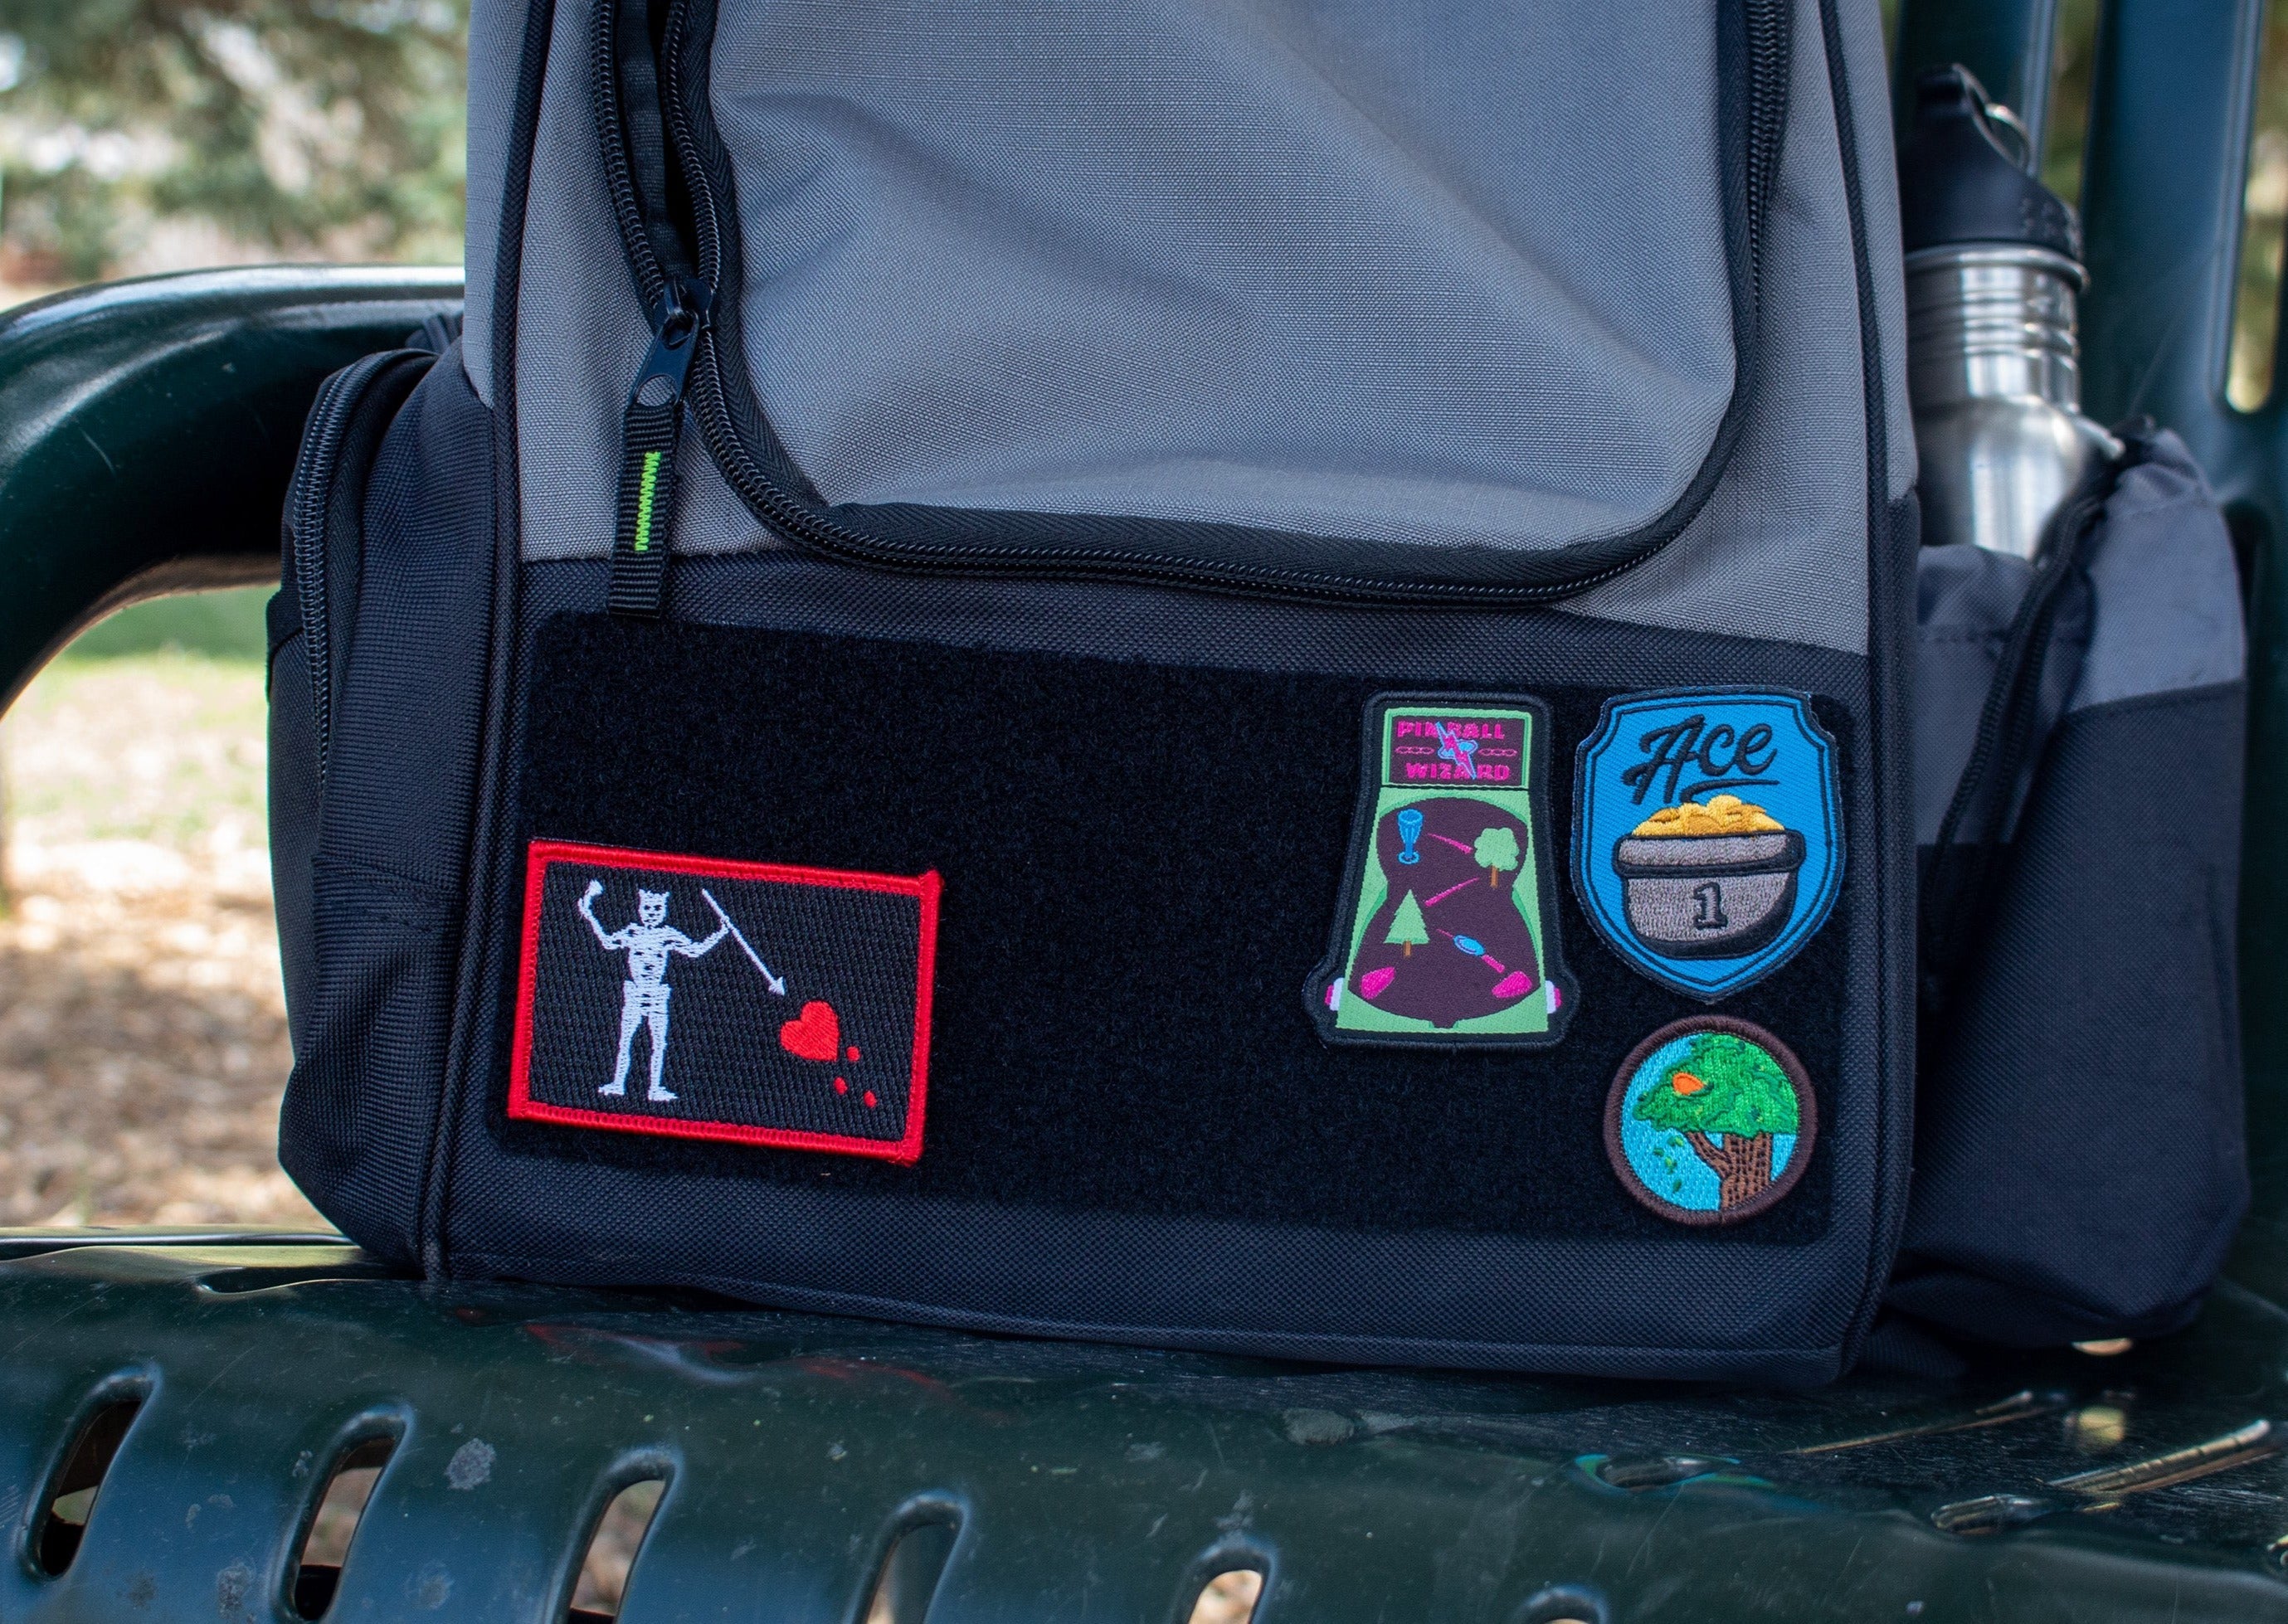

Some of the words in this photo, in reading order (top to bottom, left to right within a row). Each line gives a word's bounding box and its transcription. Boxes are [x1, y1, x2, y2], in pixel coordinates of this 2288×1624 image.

[1397, 721, 1505, 740] PINBALL
[1406, 762, 1511, 781] WIZARD
[1620, 713, 1778, 805] Ace
[1693, 882, 1728, 931] 1
